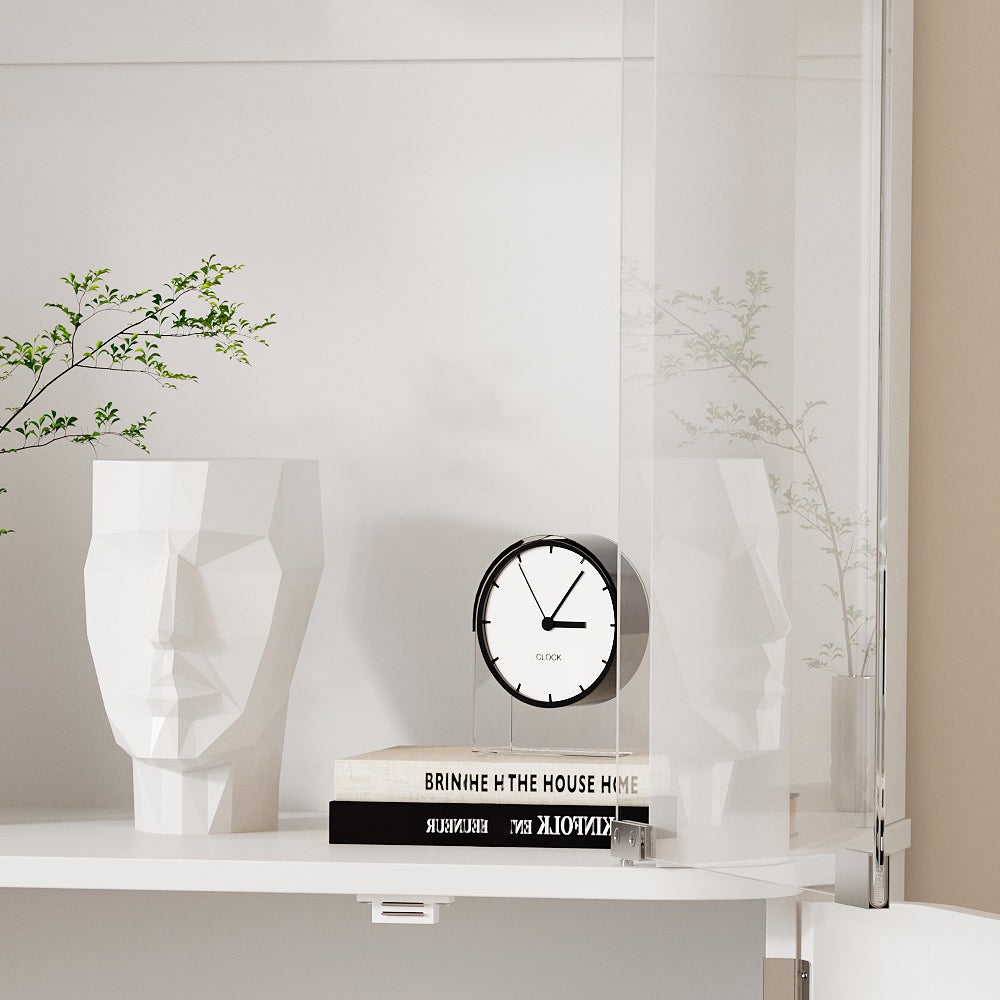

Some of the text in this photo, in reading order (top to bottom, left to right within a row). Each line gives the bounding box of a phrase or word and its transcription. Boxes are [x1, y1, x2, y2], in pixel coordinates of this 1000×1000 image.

[535, 653, 562, 662] CLOCK
[507, 773, 538, 793] THE
[543, 774, 596, 794] HOUSE
